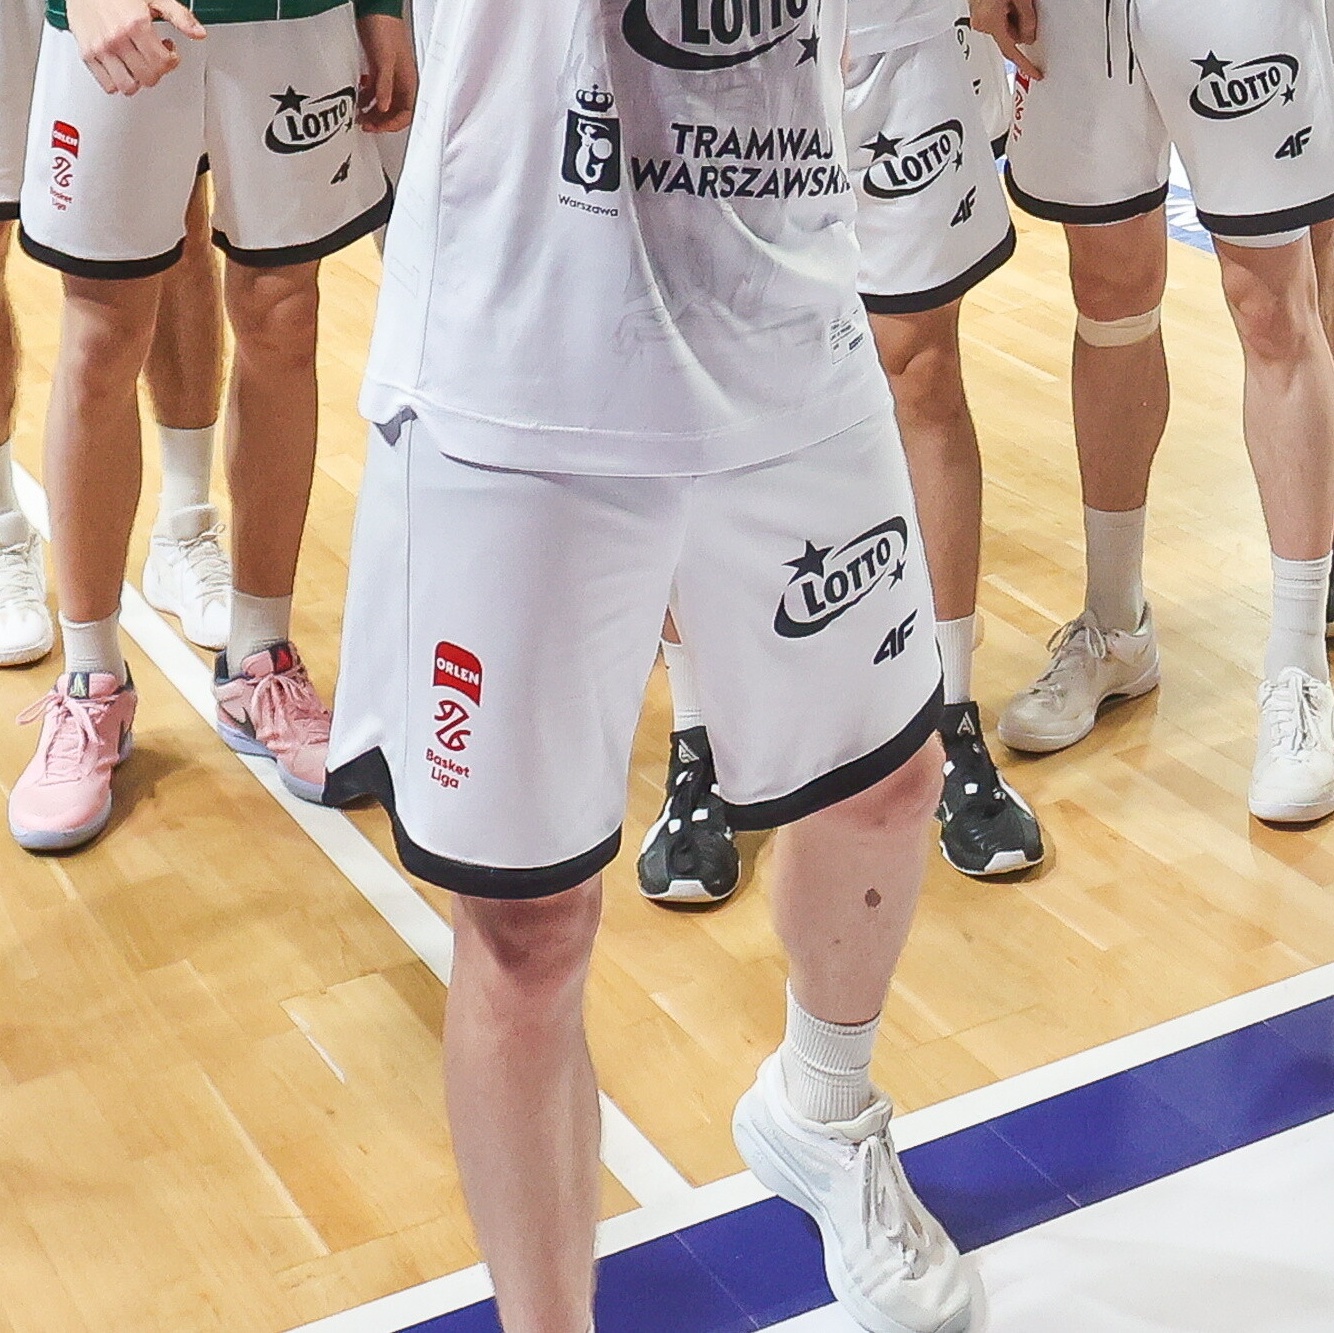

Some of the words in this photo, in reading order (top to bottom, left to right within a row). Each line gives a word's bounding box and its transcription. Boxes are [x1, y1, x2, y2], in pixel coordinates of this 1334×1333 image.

[1210, 65, 1283, 112] LOTTO
[286, 98, 349, 142] LOTTO
[671, 122, 834, 160] TRAMWAJ
[883, 134, 952, 187] LOTTO
[1273, 126, 1314, 160] 4F
[629, 157, 851, 199] WARSZAWSK
[557, 193, 619, 217] Warszawa
[949, 186, 978, 228] 4F
[801, 536, 892, 617] LOTTO
[872, 609, 919, 665] 4F
[435, 655, 480, 686] ORLEN
[425, 748, 471, 778] Basket
[430, 767, 460, 789] Liga
